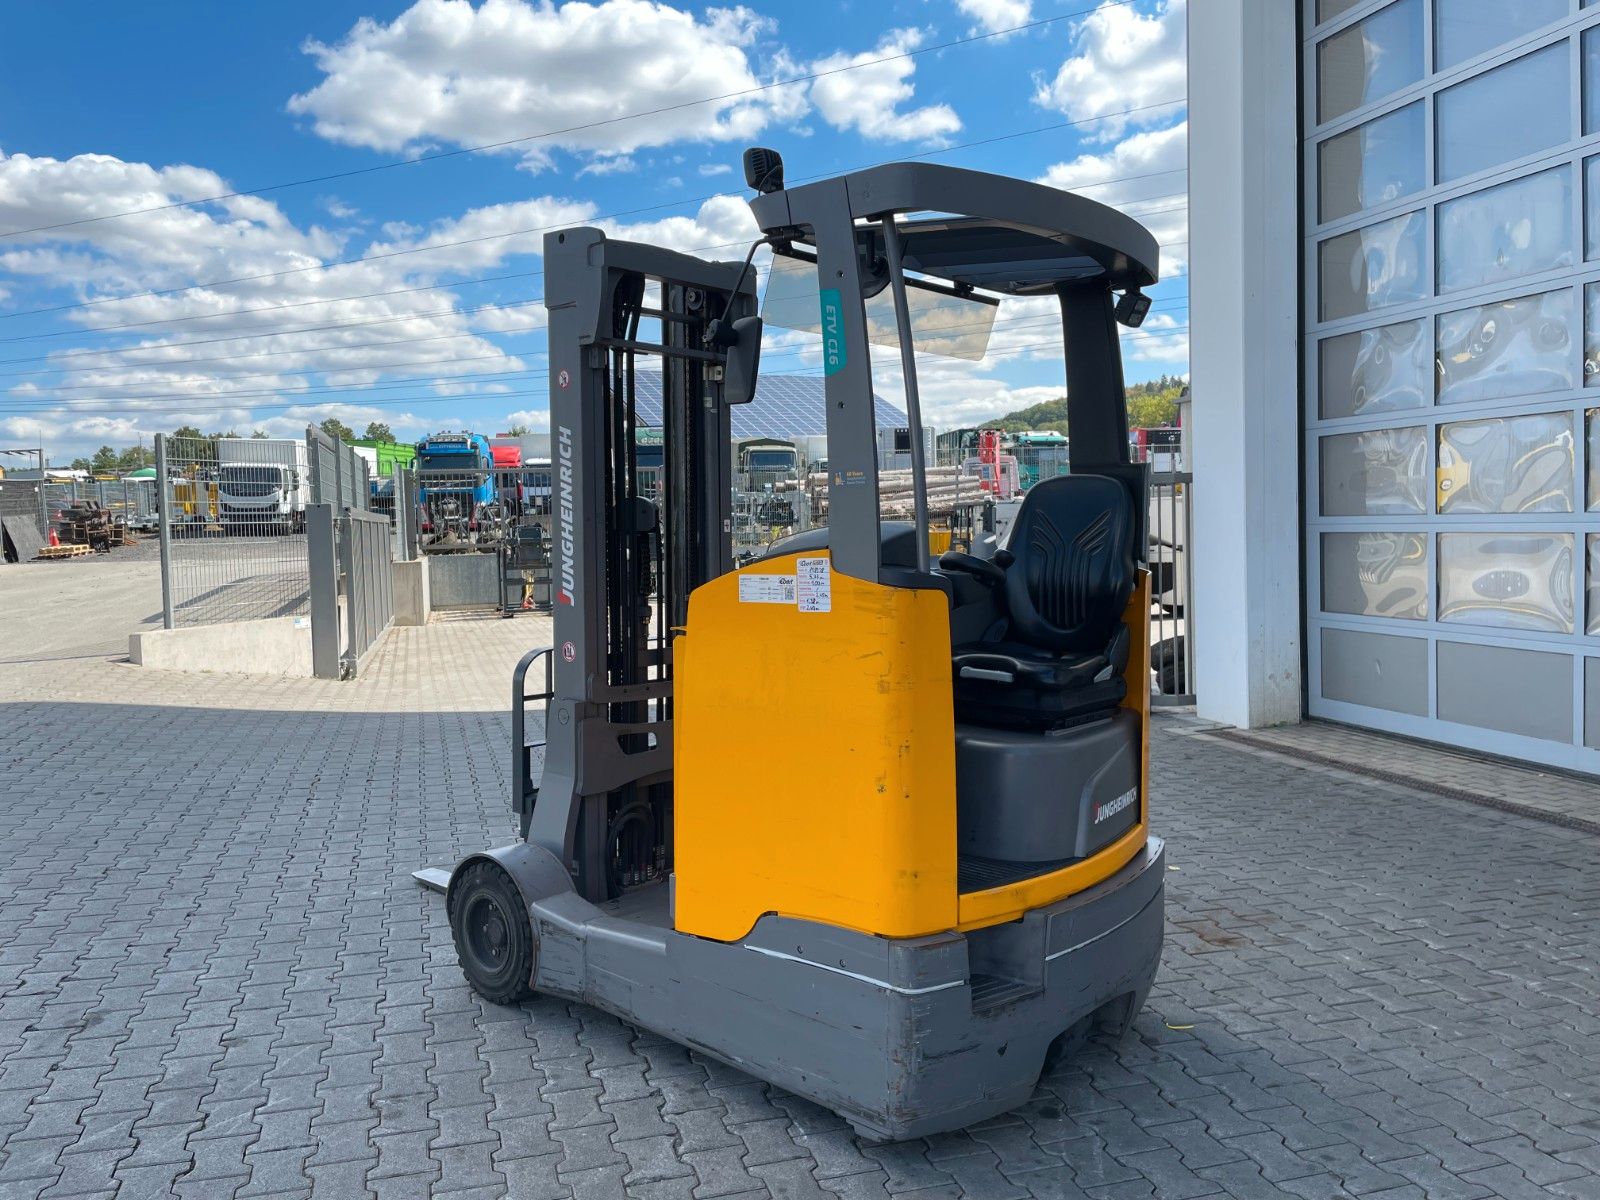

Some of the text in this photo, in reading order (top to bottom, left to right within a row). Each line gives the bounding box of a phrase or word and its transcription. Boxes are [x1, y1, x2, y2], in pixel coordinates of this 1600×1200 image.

[825, 304, 839, 365] ETV C16
[558, 426, 575, 607] JUNGHEINRICH
